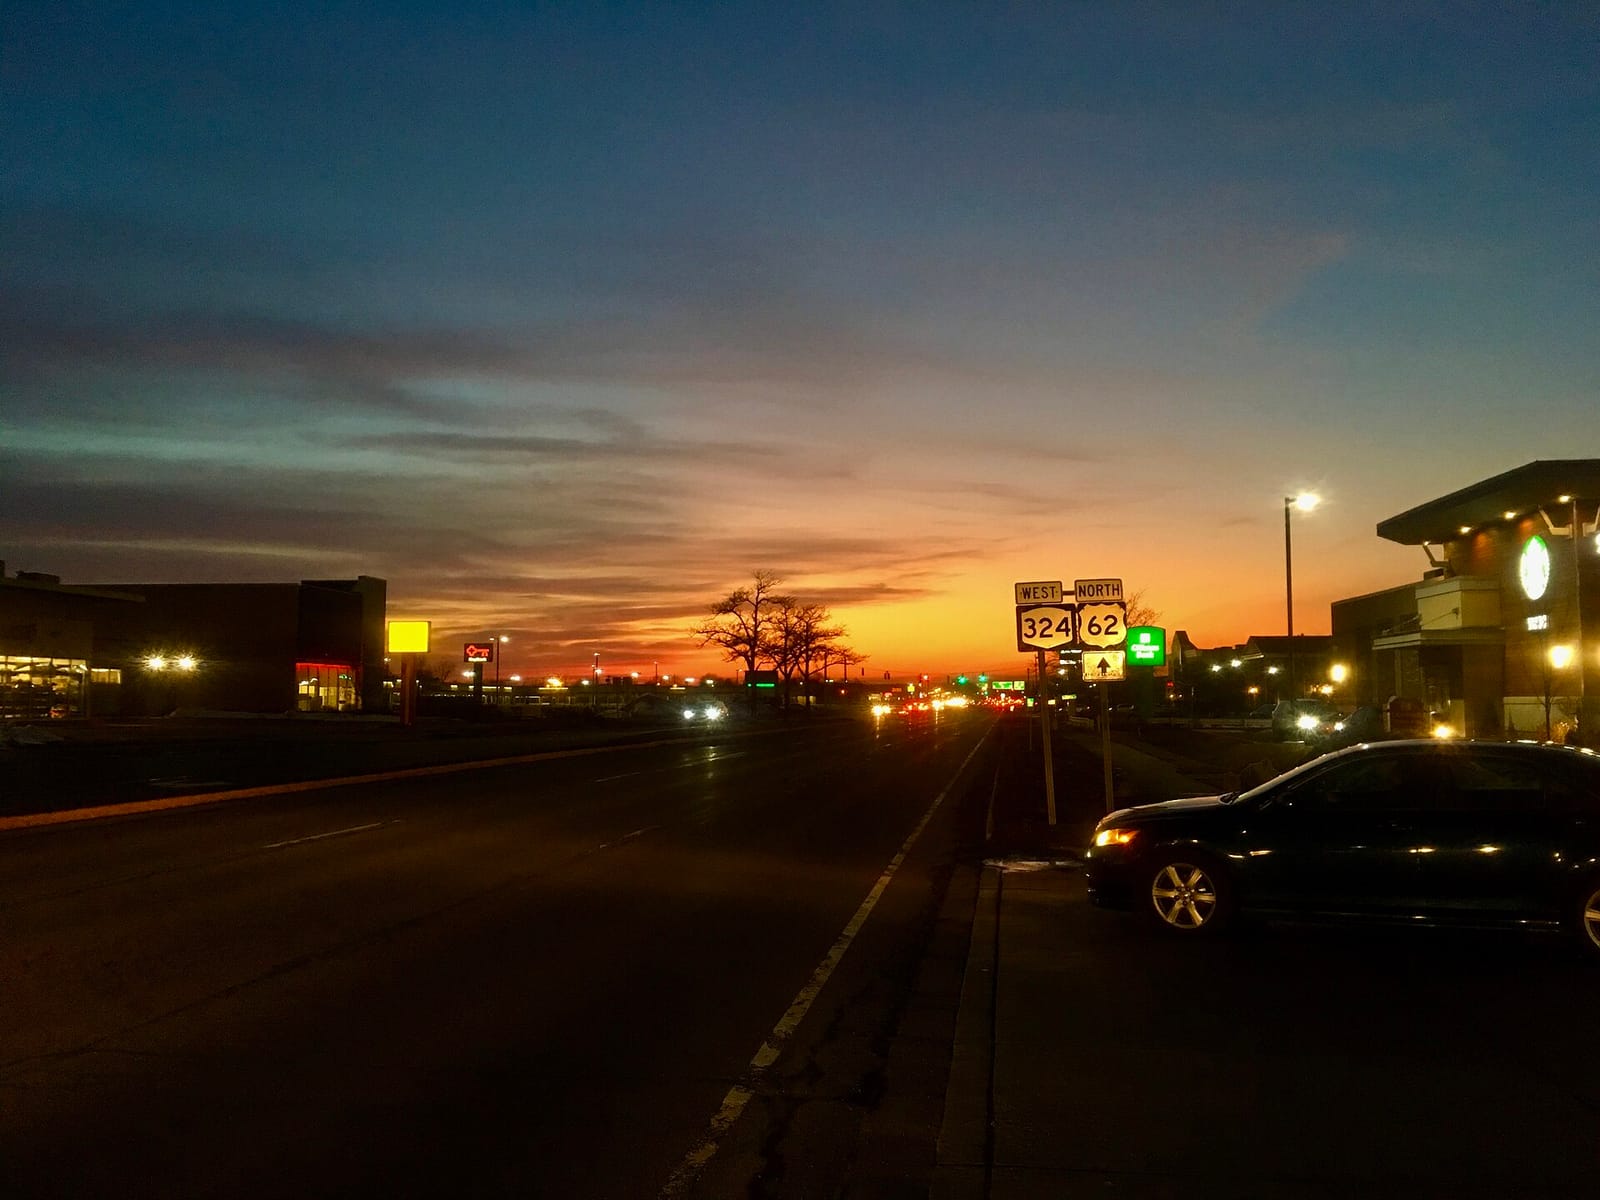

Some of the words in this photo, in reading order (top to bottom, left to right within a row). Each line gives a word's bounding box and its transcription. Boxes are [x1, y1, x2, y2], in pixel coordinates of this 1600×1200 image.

[1021, 586, 1057, 600] WEST
[1078, 584, 1120, 598] NORTH
[1023, 616, 1071, 639] 324
[1087, 614, 1119, 636] 62
